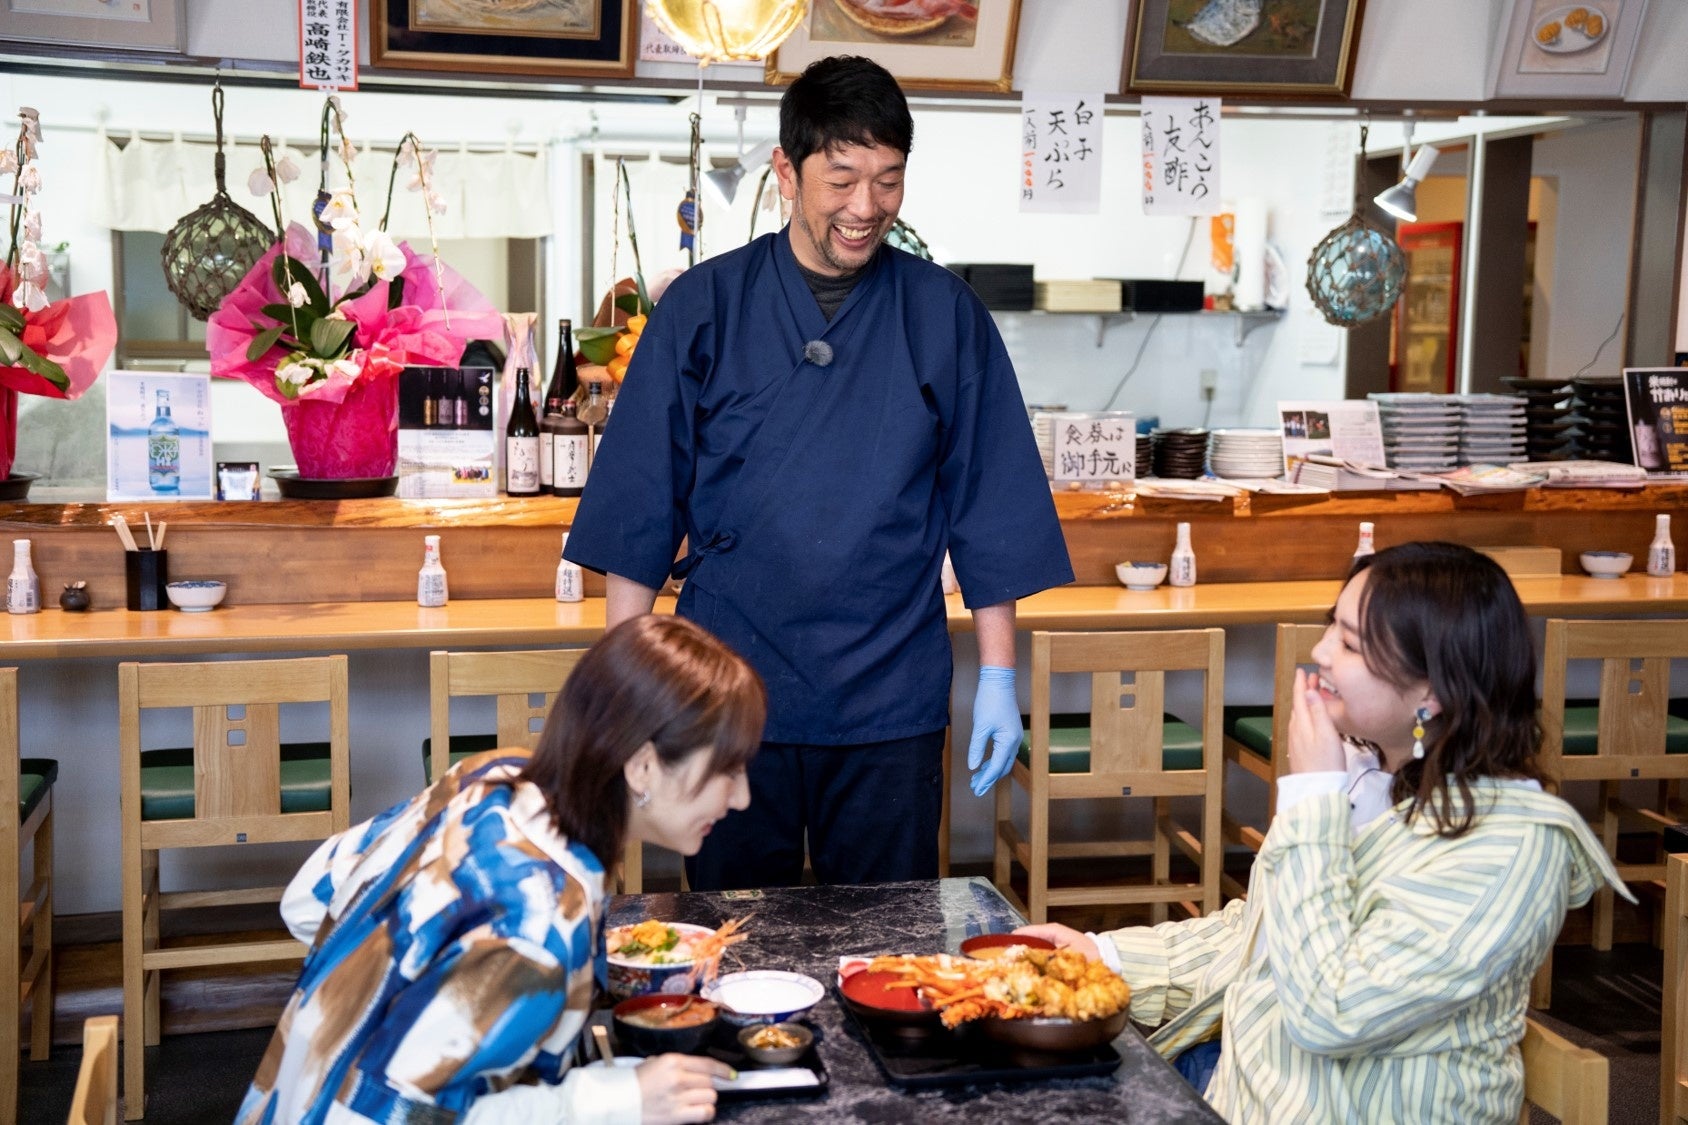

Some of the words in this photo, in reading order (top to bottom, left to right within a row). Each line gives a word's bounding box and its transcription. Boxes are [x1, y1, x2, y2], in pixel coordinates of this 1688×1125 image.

[1044, 110, 1070, 189] 天ぷら
[1073, 100, 1094, 161] 白子
[1188, 101, 1215, 200] あんこう
[1060, 448, 1133, 477] 御手元に
